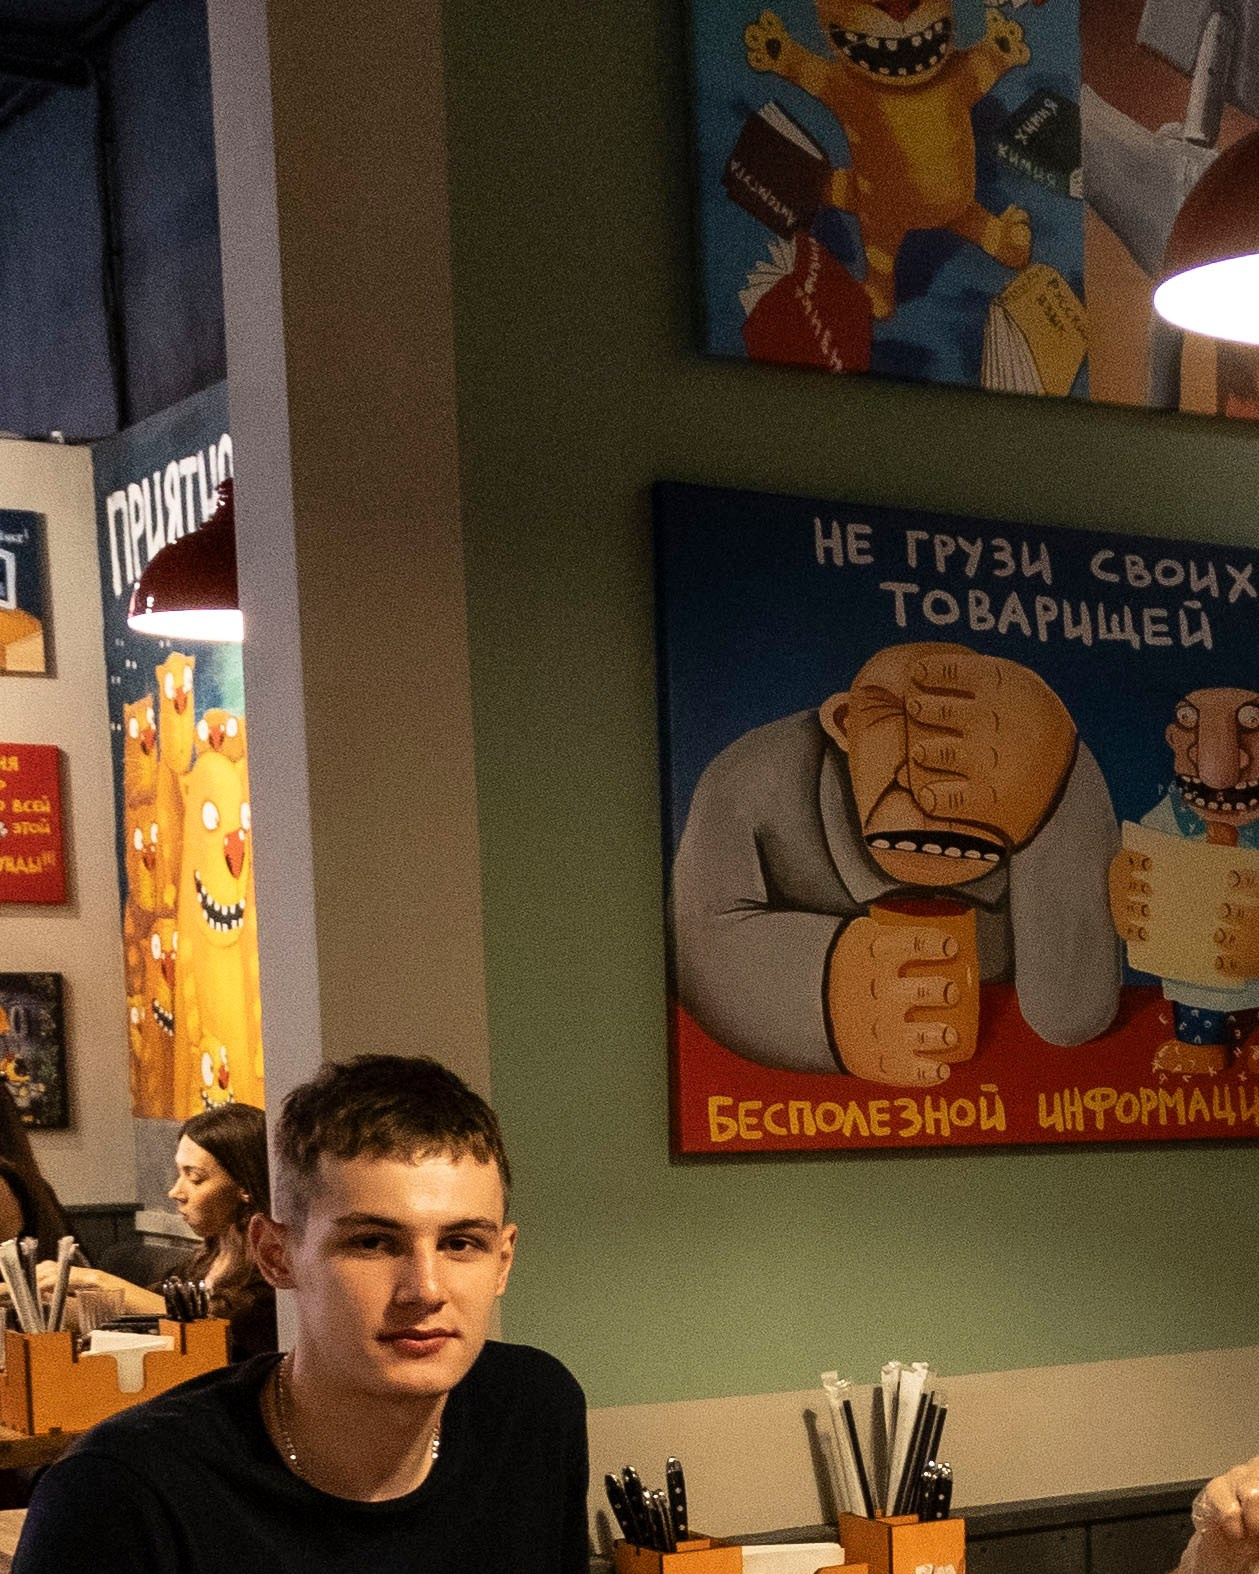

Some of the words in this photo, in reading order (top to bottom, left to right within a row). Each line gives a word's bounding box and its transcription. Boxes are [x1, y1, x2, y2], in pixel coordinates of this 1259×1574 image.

[813, 515, 875, 567] НЕ
[905, 528, 1053, 586] ГРУЗИ
[1089, 548, 1259, 604] СВОИХ
[878, 580, 1215, 652] ТОВАРИЩЕЙ
[706, 1083, 1008, 1143] БЕСПОЛЕЗНОЙ
